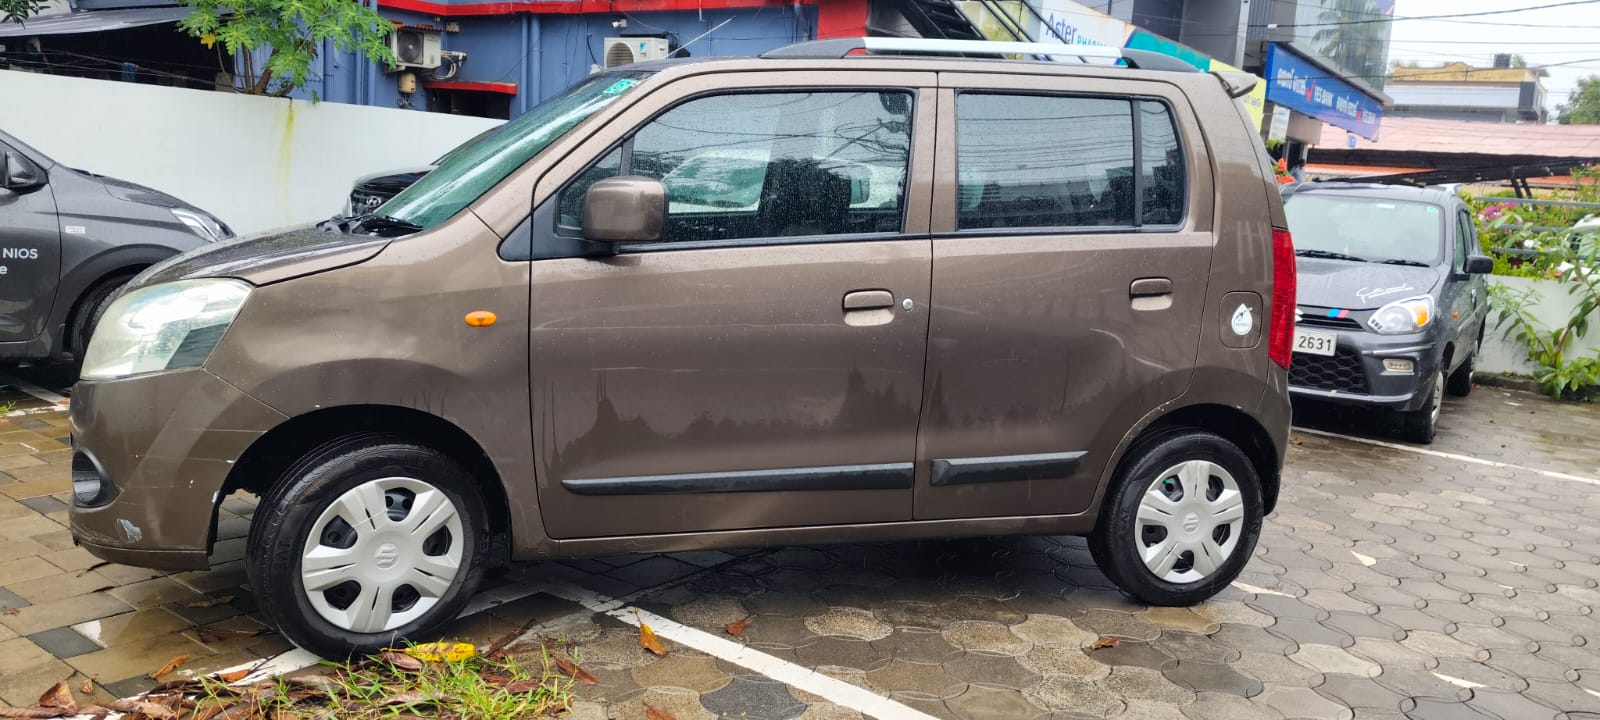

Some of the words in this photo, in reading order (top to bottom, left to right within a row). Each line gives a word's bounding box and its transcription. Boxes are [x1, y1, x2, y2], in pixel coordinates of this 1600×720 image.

[1046, 13, 1077, 45] Aster
[2, 247, 39, 260] NIOS
[1298, 335, 1332, 352] 2631
